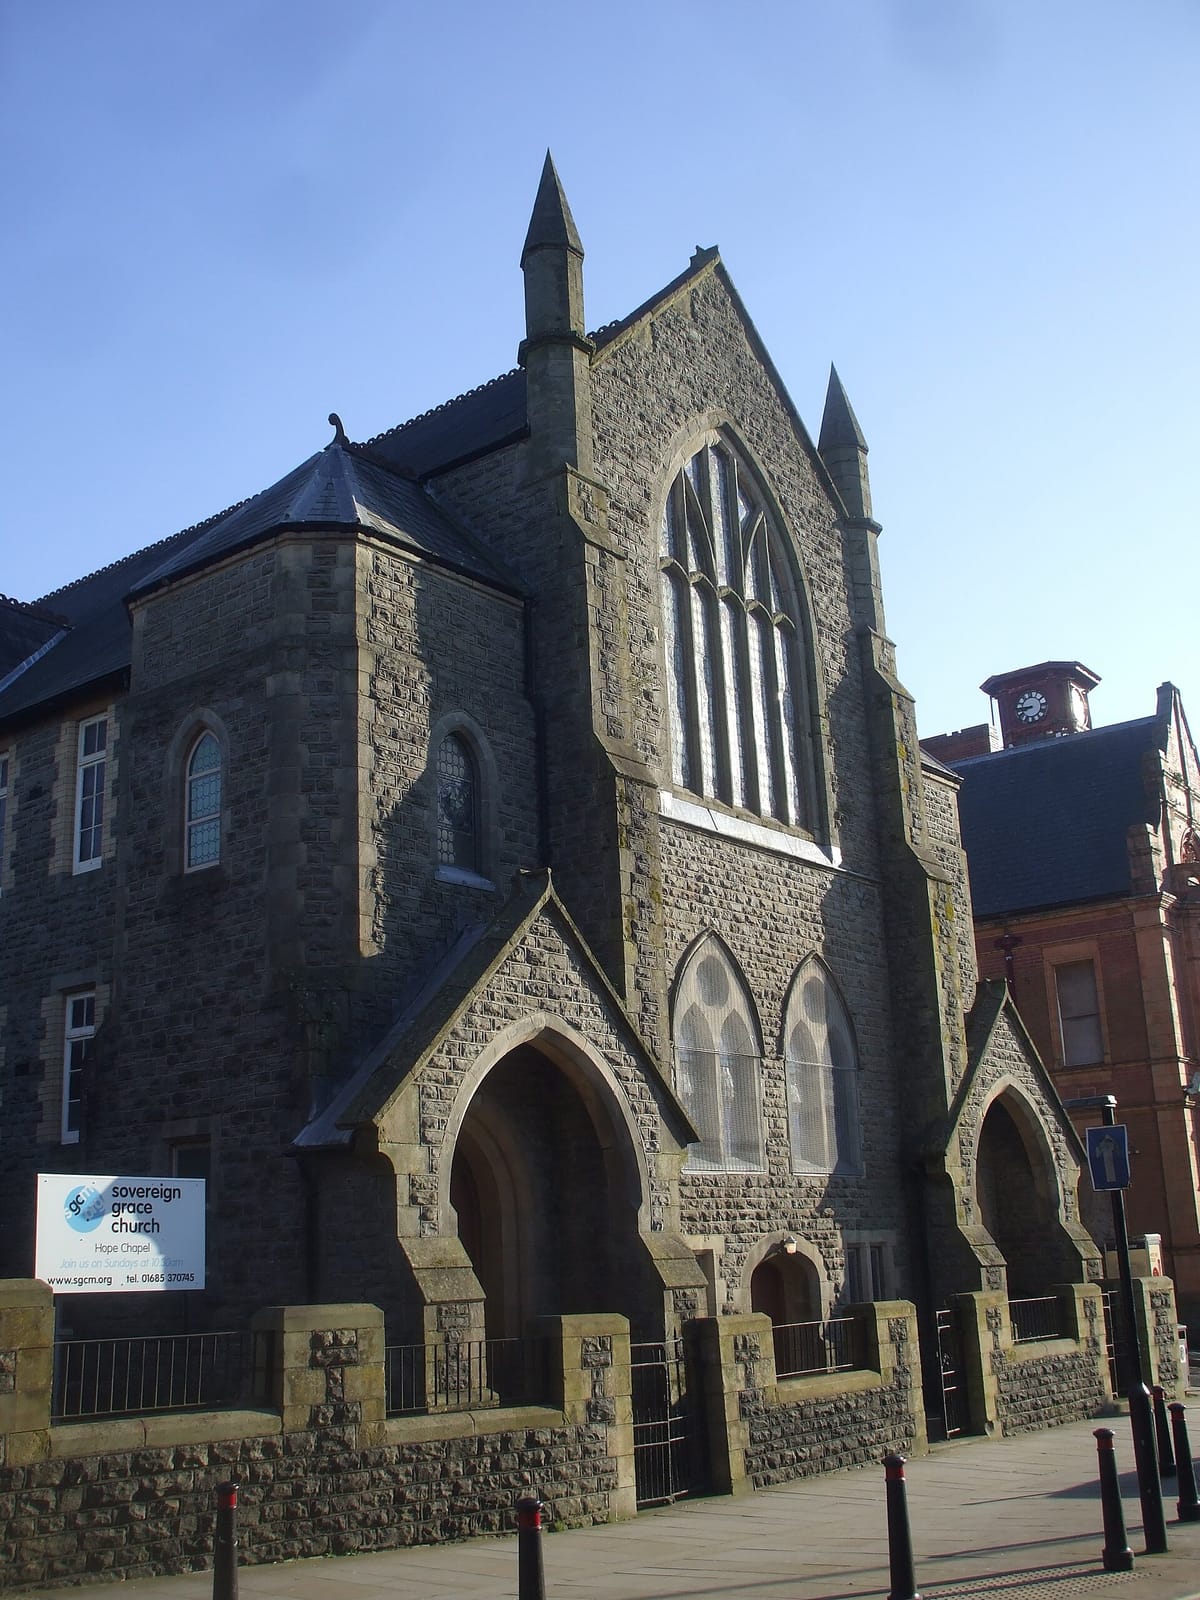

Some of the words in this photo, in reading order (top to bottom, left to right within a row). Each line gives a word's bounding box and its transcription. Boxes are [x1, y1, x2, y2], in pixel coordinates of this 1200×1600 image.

[111, 1183, 181, 1203] sovereign
[111, 1201, 153, 1217] grace
[111, 1217, 160, 1233] church
[94, 1243, 119, 1255] Hope
[120, 1242, 151, 1255] Chapel
[60, 1258, 77, 1269] Join
[79, 1260, 90, 1268] us
[91, 1259, 103, 1268] on
[104, 1257, 138, 1270] Sundays
[139, 1258, 149, 1267] at
[47, 1276, 113, 1287] www.sgcm.org
[126, 1274, 139, 1283] tel.
[141, 1273, 165, 1283] 01685
[167, 1272, 195, 1282] 370745
